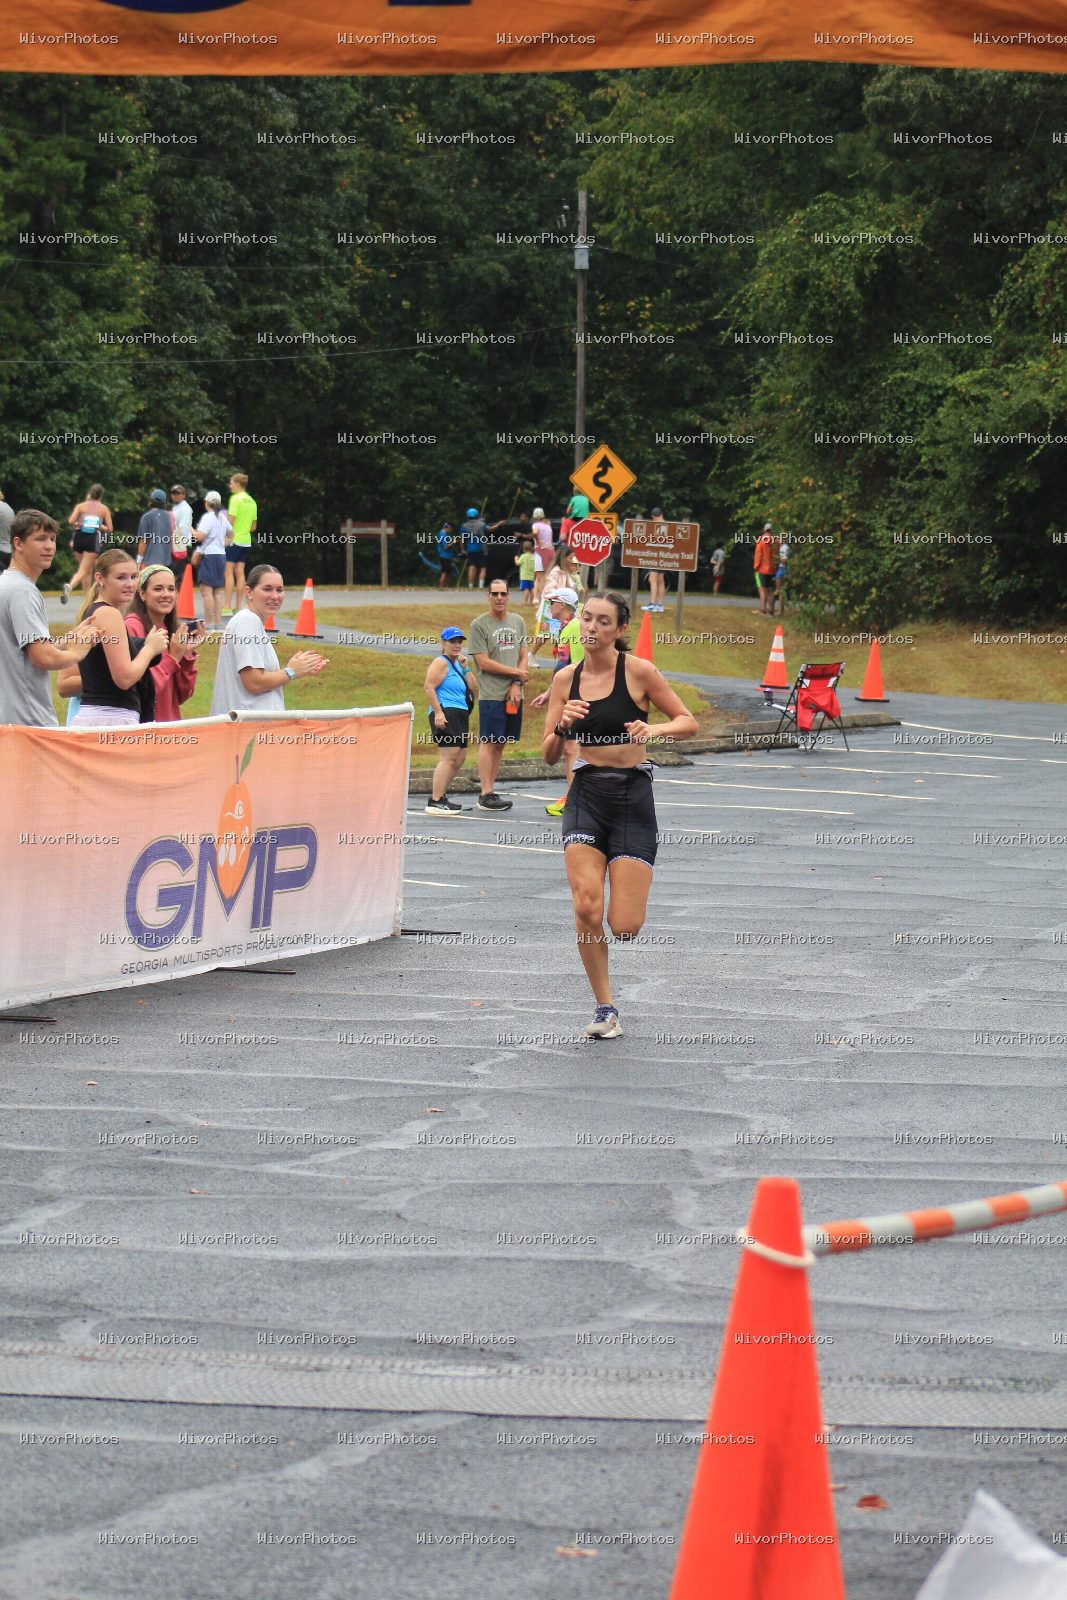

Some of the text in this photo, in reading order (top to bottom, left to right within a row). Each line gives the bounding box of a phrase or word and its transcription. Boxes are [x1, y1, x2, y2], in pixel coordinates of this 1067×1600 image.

[571, 532, 609, 552] STOP
[625, 549, 694, 560] Muscadine Nature Trail
[638, 558, 680, 568] Tennis Courts
[125, 823, 318, 952] GMP
[120, 957, 169, 975] GEORGIA
[173, 944, 244, 966] MULTISPORTS
